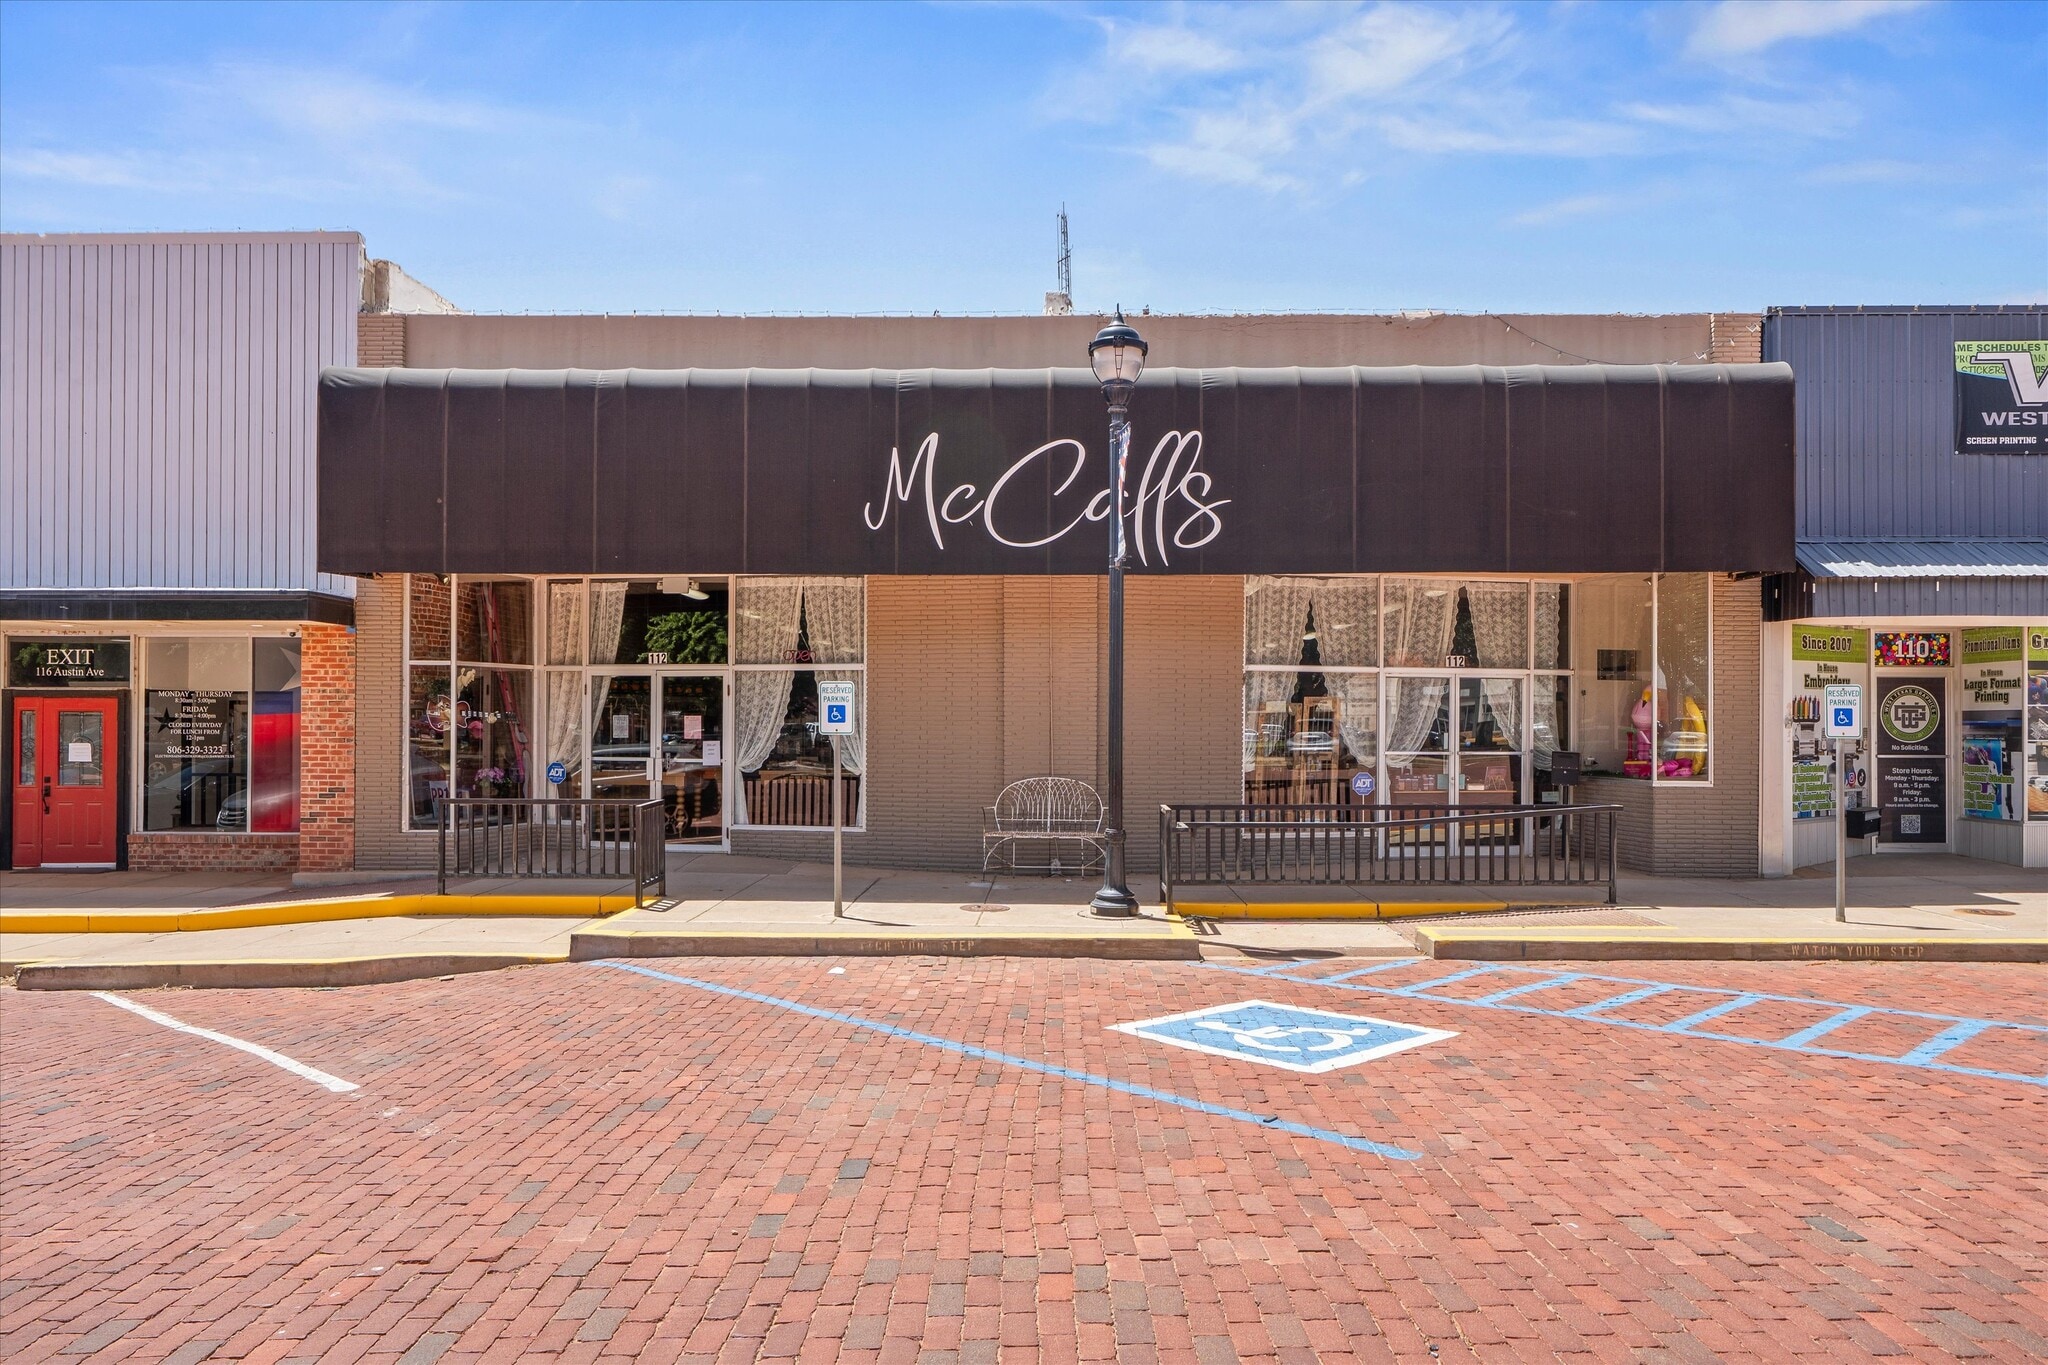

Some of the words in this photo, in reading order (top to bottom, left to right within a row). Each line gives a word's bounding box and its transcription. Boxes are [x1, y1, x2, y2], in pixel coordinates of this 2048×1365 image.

[1955, 344, 1973, 352] ME
[1976, 343, 2041, 352] SCHEDULES
[1981, 411, 2048, 426] WEST
[1966, 437, 1998, 445] SCREEN
[1999, 436, 2037, 444] PRINTING
[1802, 635, 1827, 650] Since
[1829, 636, 1852, 651] 2007
[1964, 637, 2001, 652] Promotional
[2002, 636, 2020, 650] Items
[1895, 640, 1929, 658] 110
[46, 648, 95, 665] EXIT
[649, 653, 667, 664] 112
[1446, 656, 1465, 667] 112
[36, 667, 52, 677] 116
[53, 666, 84, 677] Austin
[86, 667, 105, 677] Ave
[1964, 679, 1988, 691] Large
[1990, 677, 2021, 689] Format
[822, 686, 852, 694] RESERVED
[1974, 691, 2009, 704] Printing
[166, 745, 223, 754] 806-329-3323
[1900, 744, 1930, 752] Soliciting.
[548, 768, 565, 777] ADT
[1355, 778, 1372, 788] ADT
[942, 940, 975, 952] STEP
[1791, 944, 1837, 956] WATCH
[1847, 945, 1880, 957] YOUR
[1891, 946, 1924, 957] STEP
